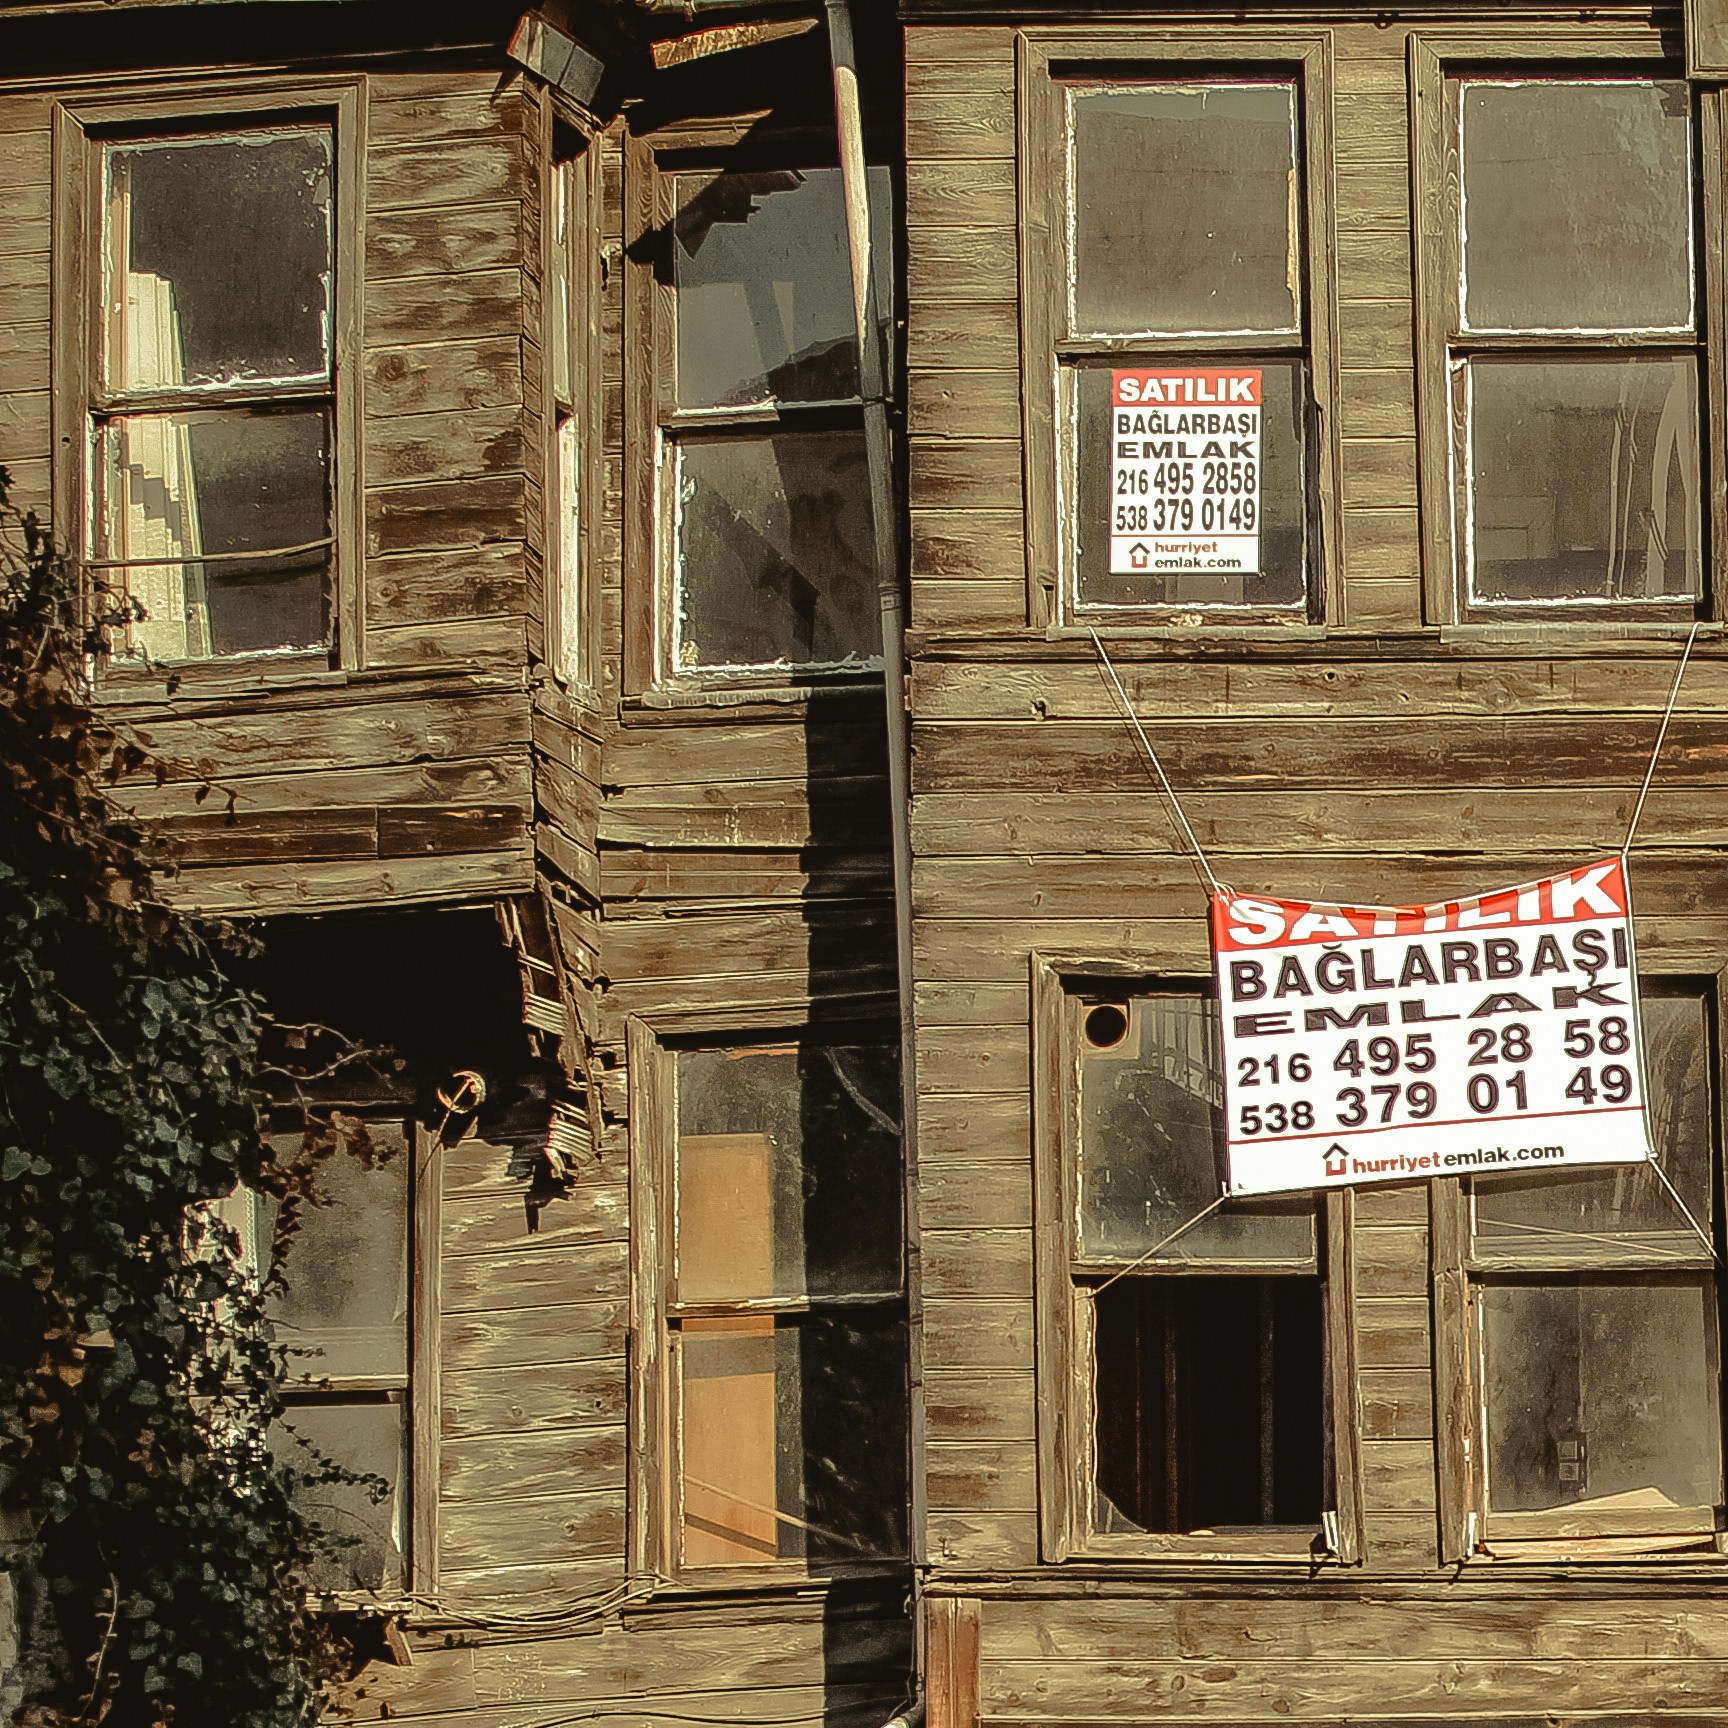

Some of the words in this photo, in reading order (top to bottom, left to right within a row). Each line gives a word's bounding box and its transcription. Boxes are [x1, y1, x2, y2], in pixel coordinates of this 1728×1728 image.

[1118, 377, 1255, 402] SATILIK
[1116, 410, 1257, 438] BAĞLARBAŞI
[1117, 441, 1256, 459] EMLAK
[1116, 469, 1148, 495] 216
[1153, 462, 1194, 495] 495
[1202, 462, 1256, 495] 2858
[1116, 505, 1148, 531] 538
[1152, 498, 1194, 531] 379
[1201, 498, 1256, 531] 0149
[1154, 541, 1218, 554] hurriyet
[1154, 557, 1242, 568] emlak.com
[1230, 928, 1629, 1002] BAĞLARBAŞI
[1234, 981, 1629, 1038] EMLAK
[1238, 1054, 1312, 1088] 216
[1333, 1033, 1437, 1077] 495
[1467, 1024, 1533, 1067] 28
[1564, 1016, 1630, 1059] 58
[1239, 1100, 1315, 1136] 538
[1336, 1081, 1437, 1128] 379
[1467, 1070, 1528, 1114] 01
[1565, 1064, 1632, 1105] 49
